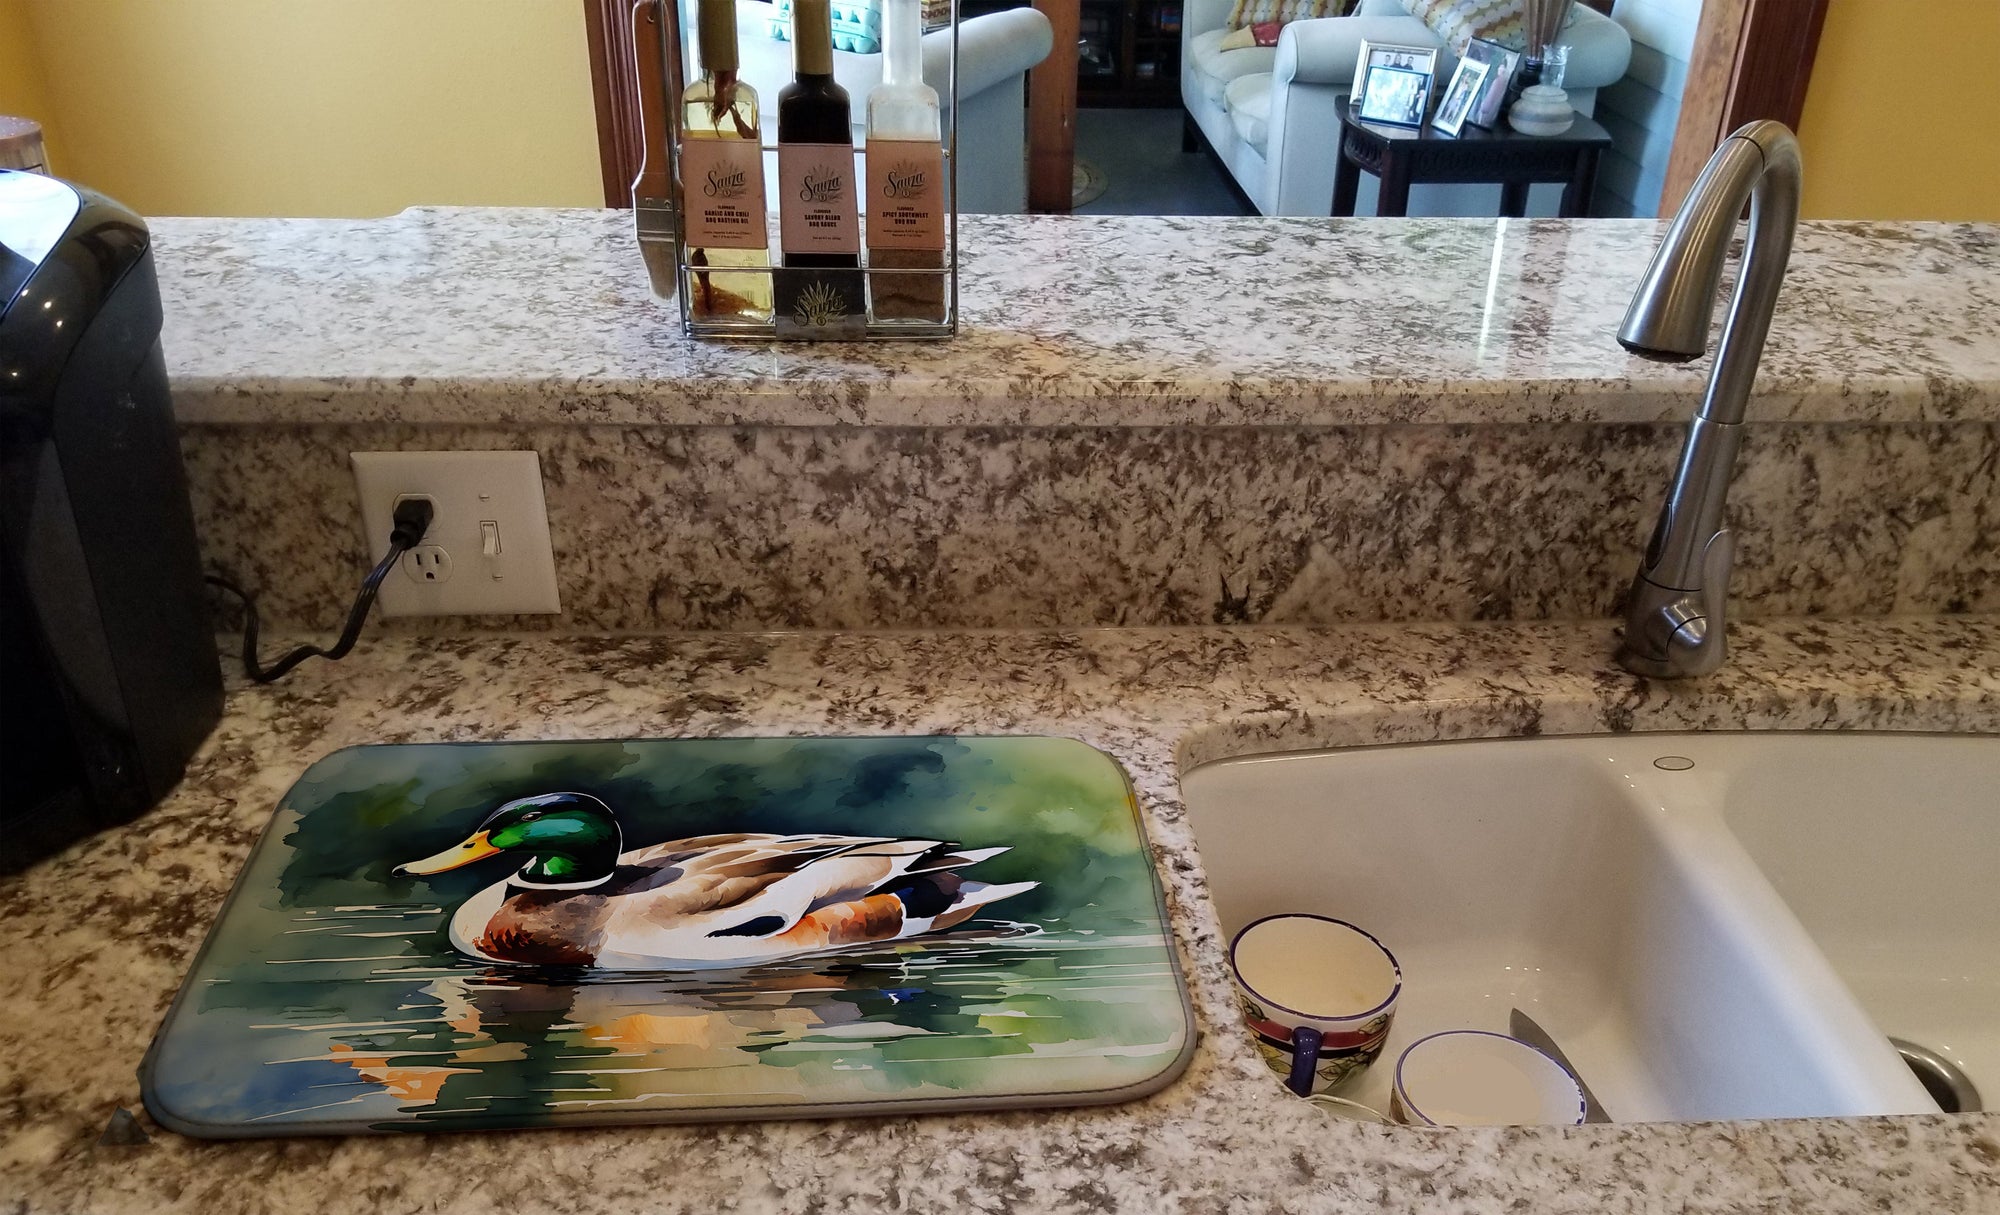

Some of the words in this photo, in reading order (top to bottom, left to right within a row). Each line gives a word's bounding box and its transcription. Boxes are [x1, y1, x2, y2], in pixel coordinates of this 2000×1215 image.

[704, 170, 746, 197] Sauza
[800, 175, 841, 202] Sauza
[883, 170, 925, 198] Sauza
